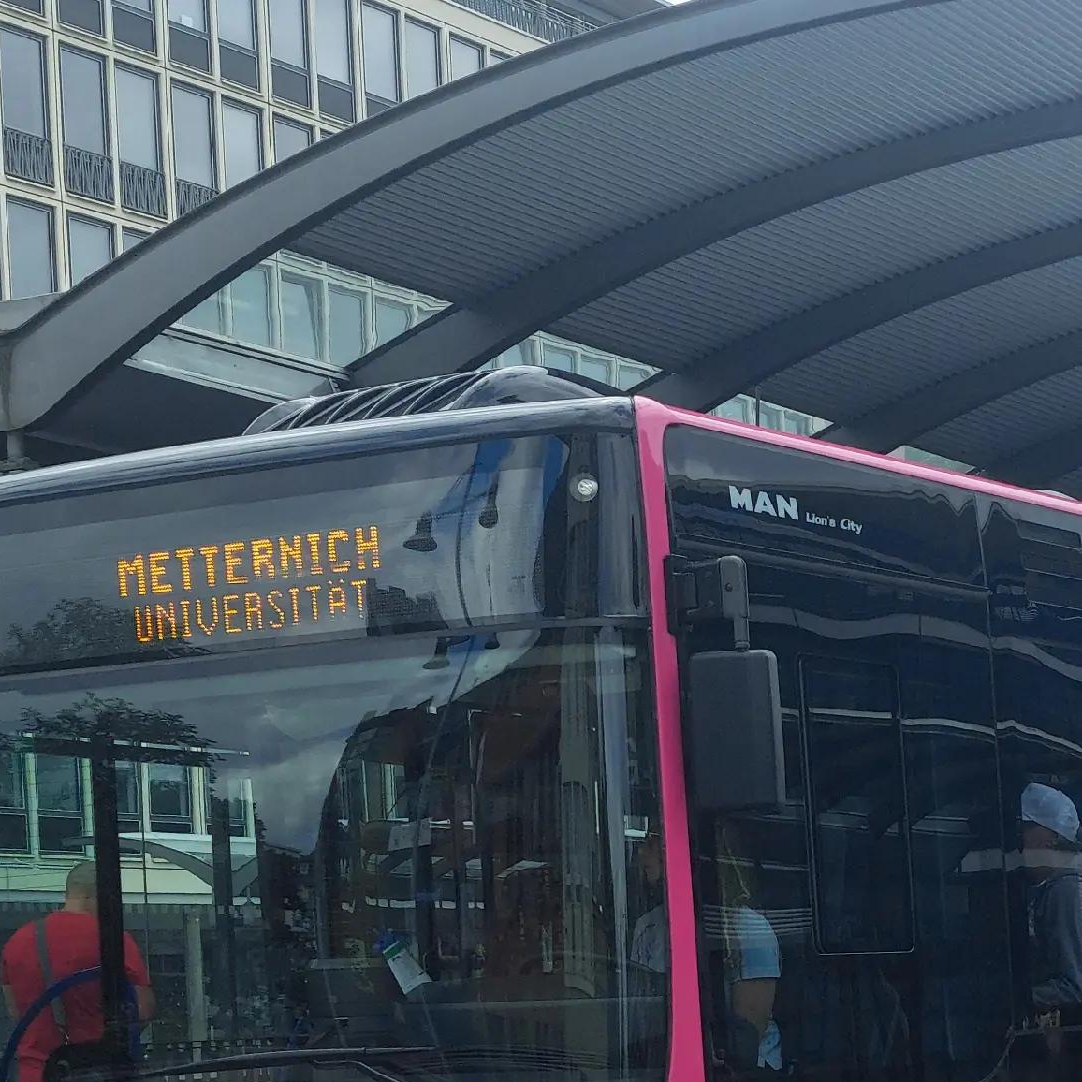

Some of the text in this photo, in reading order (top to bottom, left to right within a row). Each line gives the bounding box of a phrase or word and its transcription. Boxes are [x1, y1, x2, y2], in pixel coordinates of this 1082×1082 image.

[729, 485, 862, 535] MAN Lion's City
[117, 525, 380, 598] METTERNICH
[134, 578, 367, 642] UNIVERSITÄT
